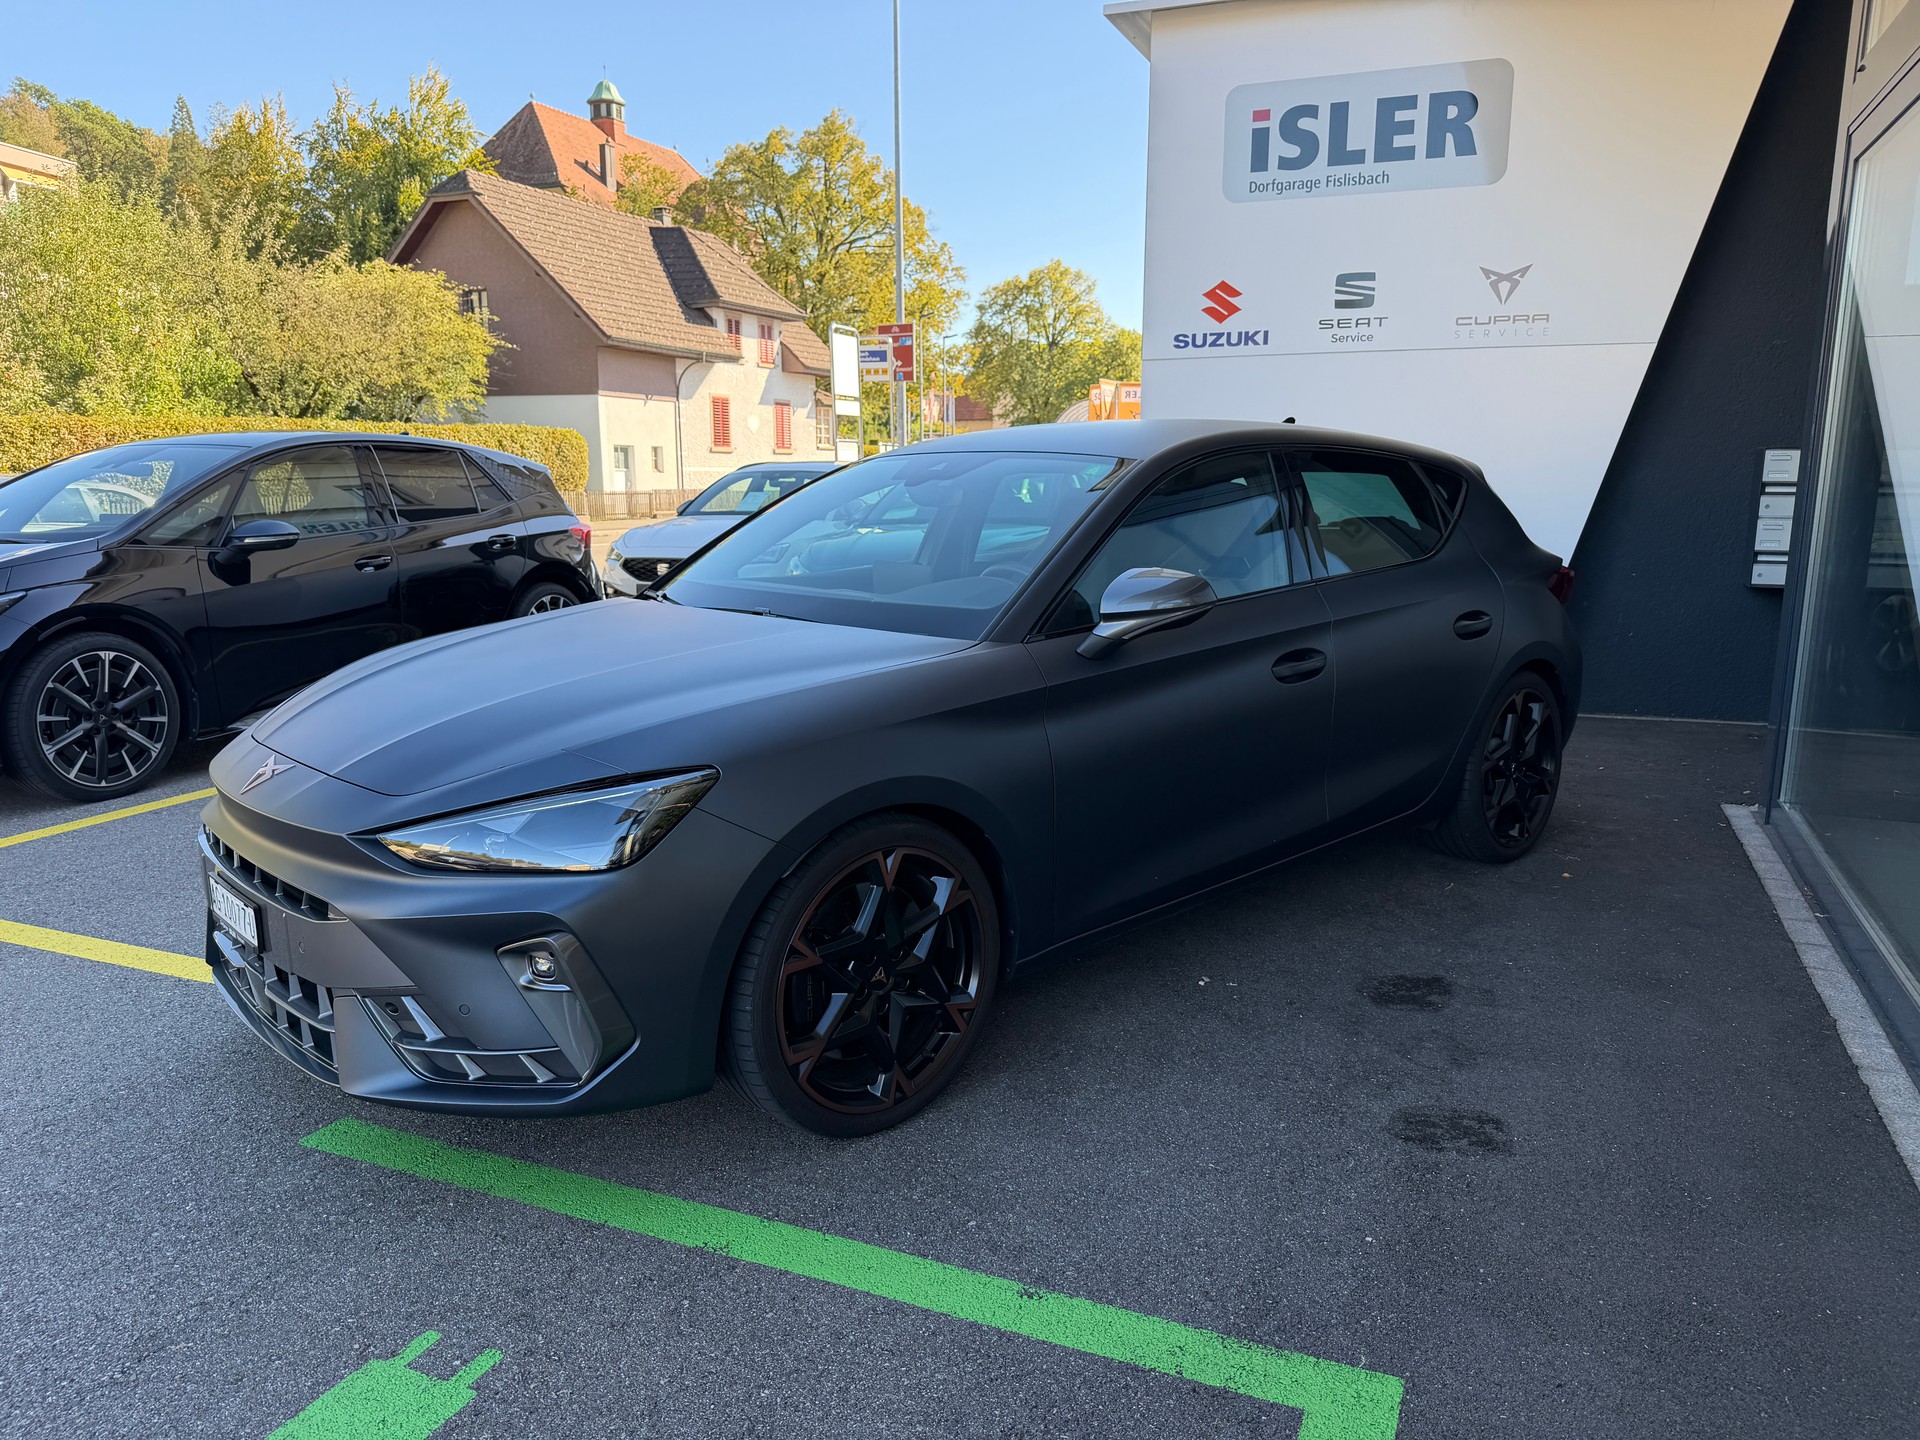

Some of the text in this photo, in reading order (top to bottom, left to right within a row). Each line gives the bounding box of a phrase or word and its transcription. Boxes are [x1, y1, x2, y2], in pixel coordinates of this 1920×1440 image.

[1249, 171, 1390, 196] Dorfgarage Fislisbach
[1319, 317, 1388, 330] SEAT
[1455, 314, 1550, 326] CUPRA
[1173, 330, 1269, 349] SUZUKI
[1331, 333, 1374, 343] Service
[1454, 328, 1549, 339] SERVICE
